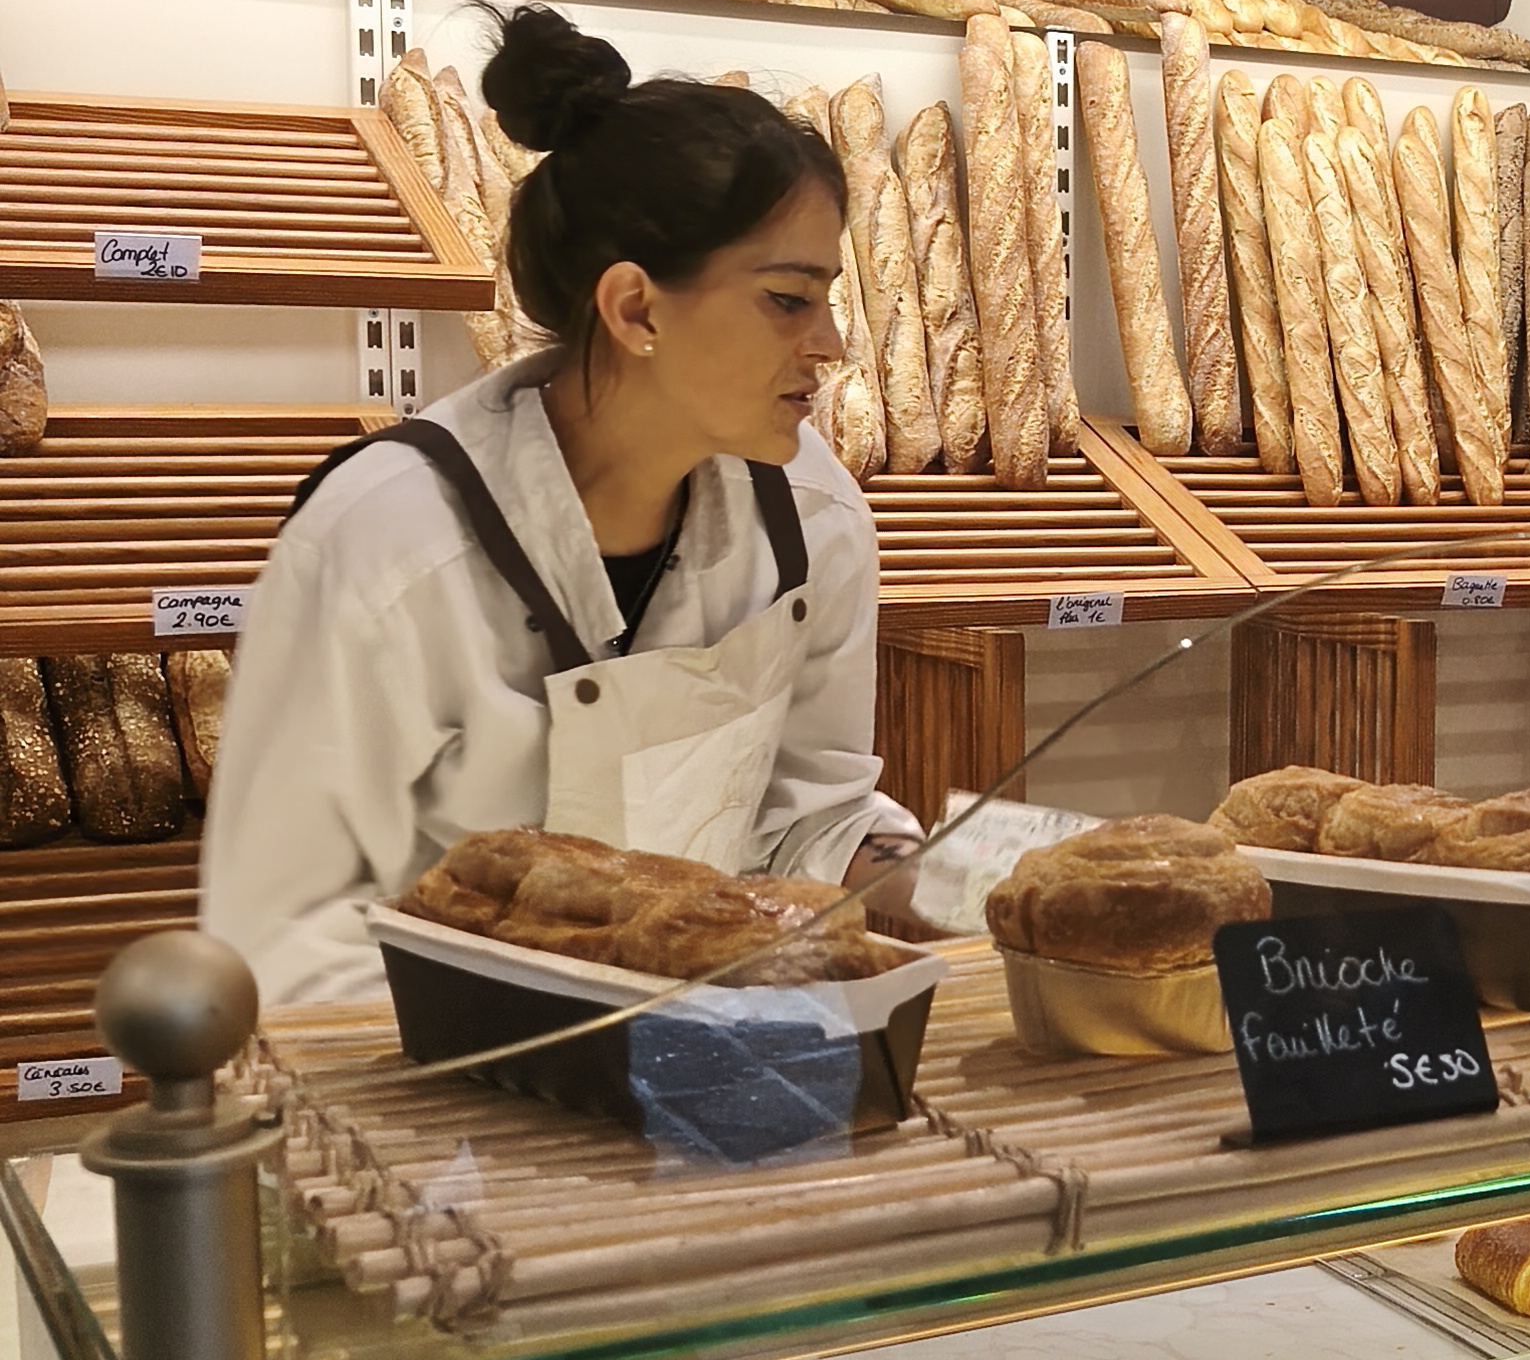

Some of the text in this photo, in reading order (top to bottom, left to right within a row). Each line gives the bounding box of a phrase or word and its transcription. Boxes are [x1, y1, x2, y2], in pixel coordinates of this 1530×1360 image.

[101, 238, 169, 266] Complet
[157, 595, 243, 610] Campagne
[172, 611, 235, 628] 2.90€
[1256, 936, 1429, 994] Brioche
